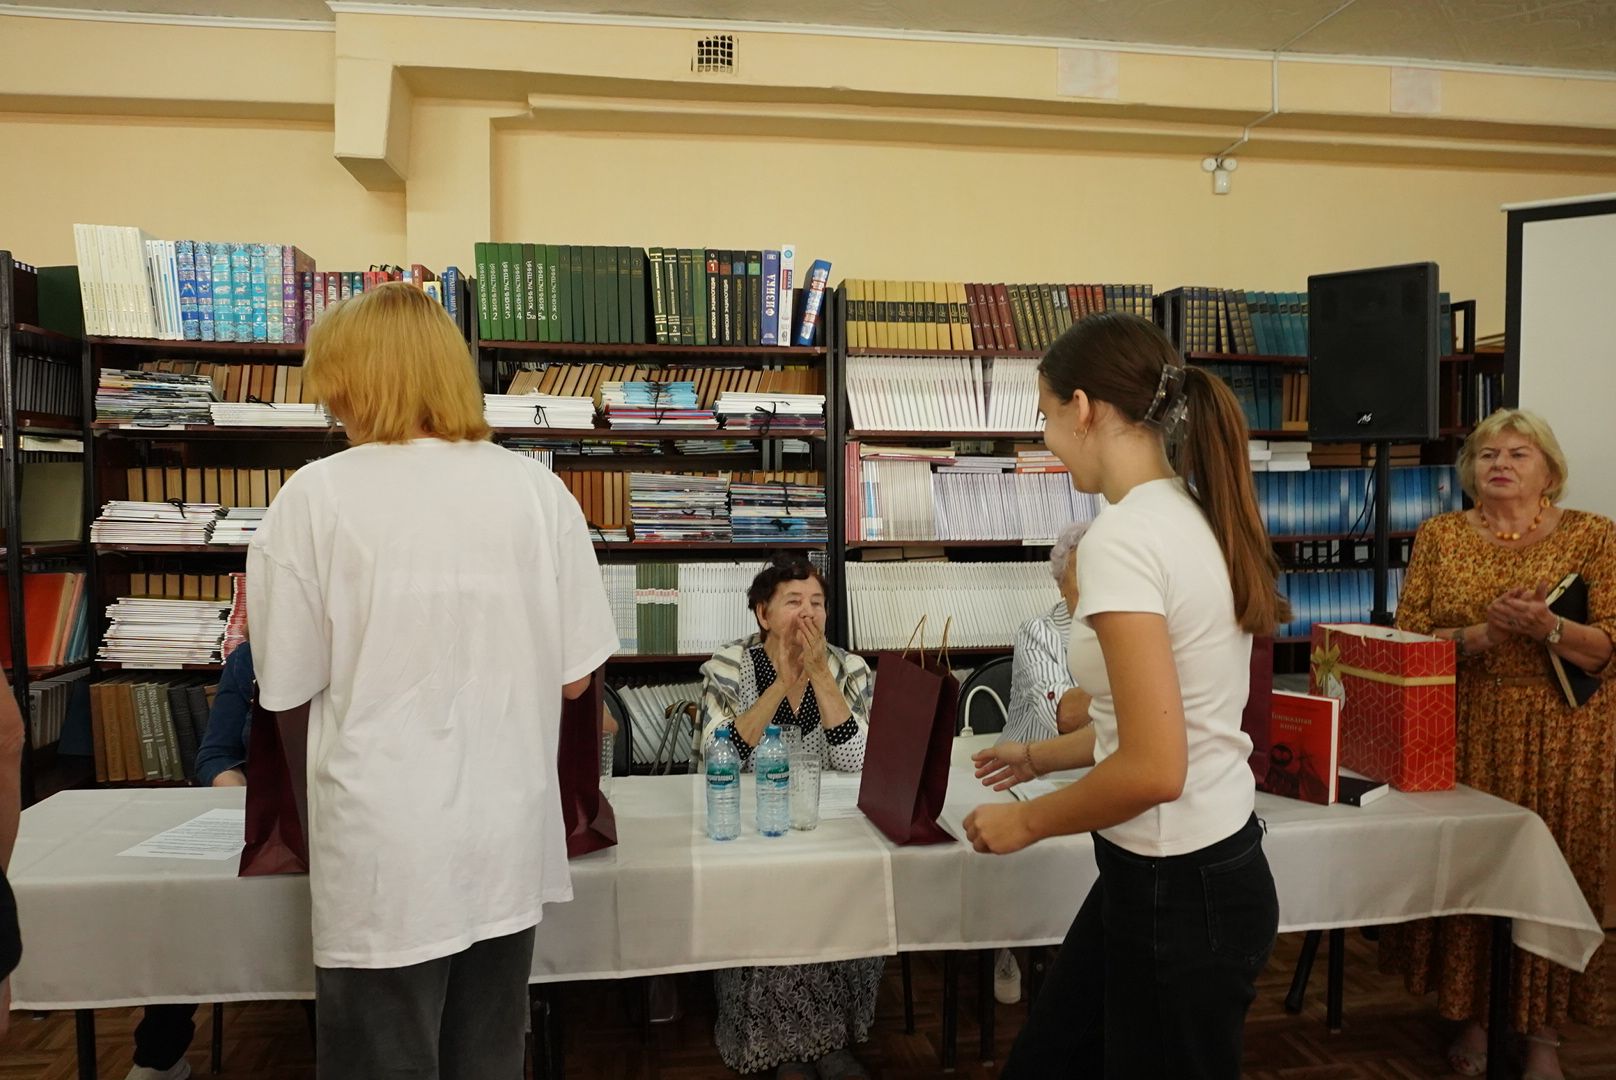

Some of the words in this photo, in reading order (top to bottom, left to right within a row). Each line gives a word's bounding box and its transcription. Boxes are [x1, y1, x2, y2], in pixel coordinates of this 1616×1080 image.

[489, 263, 497, 293] РАСТЕНИЙ
[537, 263, 545, 293] РАСТЕНИЙ
[764, 273, 777, 317] ФИЗИКА
[483, 312, 487, 320] 1
[492, 312, 498, 320] 2
[505, 311, 511, 319] 3
[517, 312, 522, 320] 4
[551, 312, 558, 320] 6
